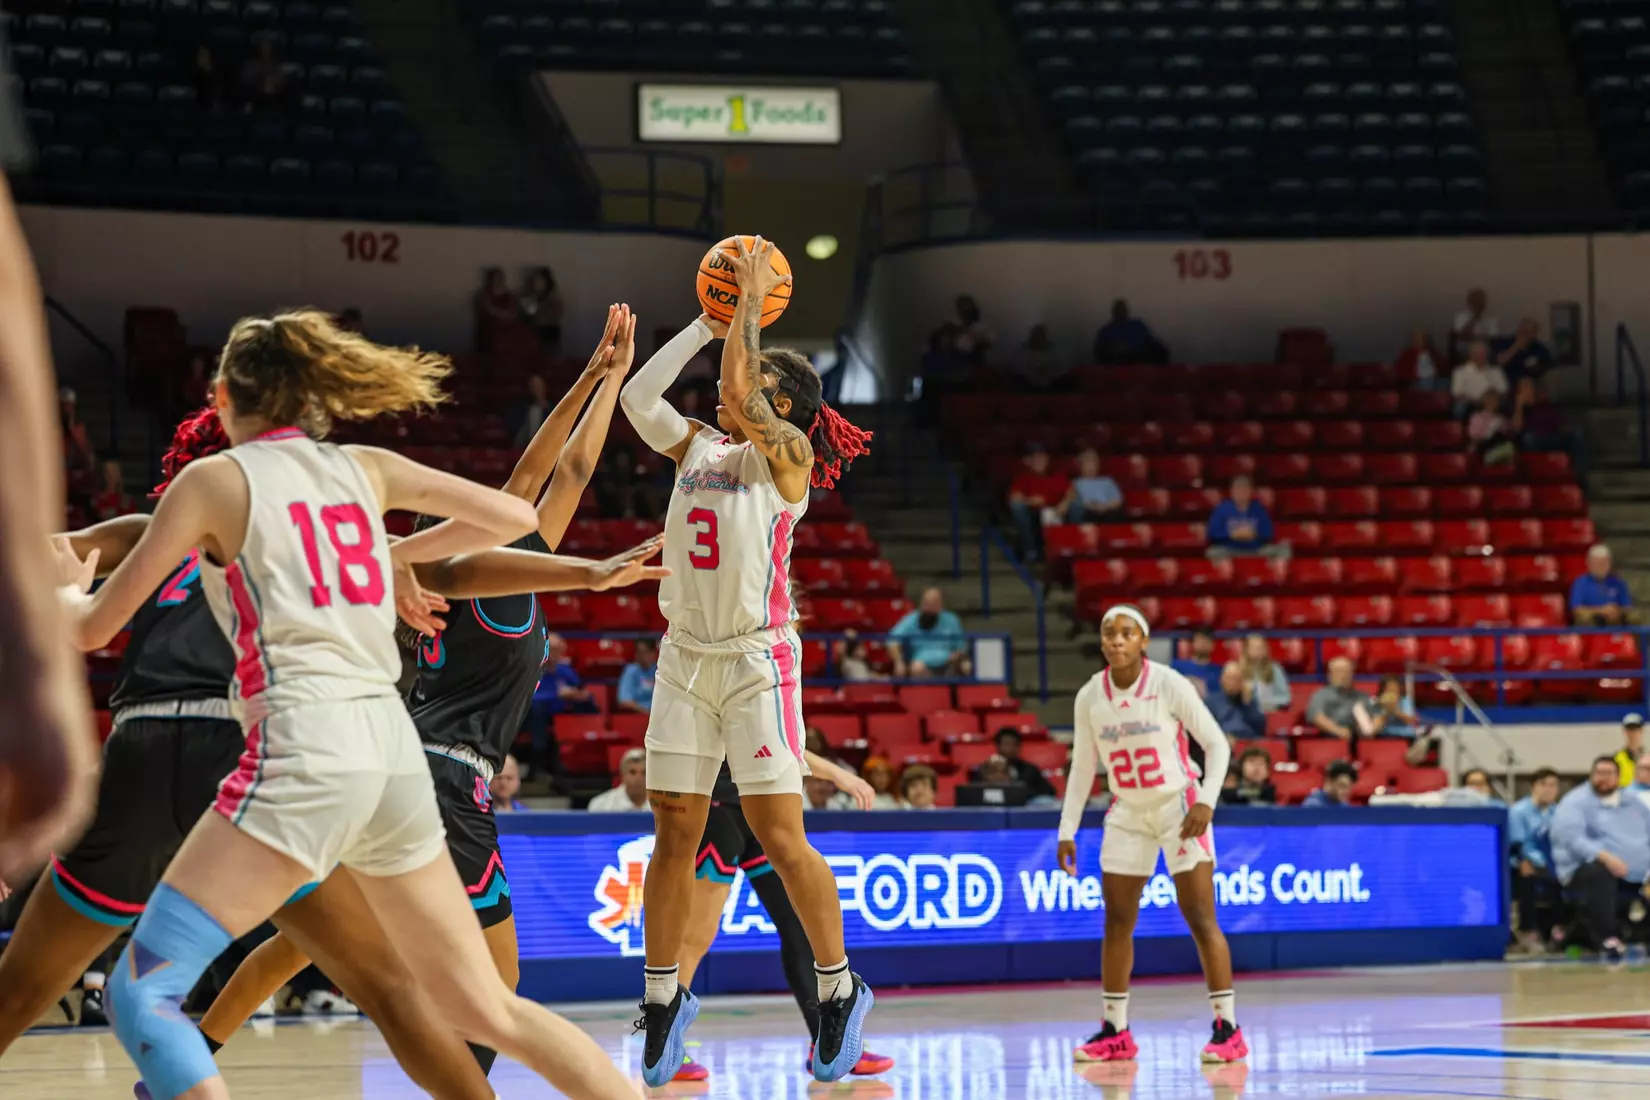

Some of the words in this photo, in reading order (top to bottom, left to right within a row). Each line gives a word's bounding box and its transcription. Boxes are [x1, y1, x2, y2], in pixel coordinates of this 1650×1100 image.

[650, 97, 723, 129] Super
[728, 96, 748, 132] 1
[752, 99, 827, 123] Foods
[340, 230, 400, 264] 102
[1170, 248, 1232, 281] 103
[705, 284, 739, 307] NCA
[287, 501, 386, 608] 18
[687, 506, 720, 571] 3
[1109, 747, 1165, 788] 22
[1018, 869, 1106, 912] Whe
[1271, 863, 1371, 904] Count.
